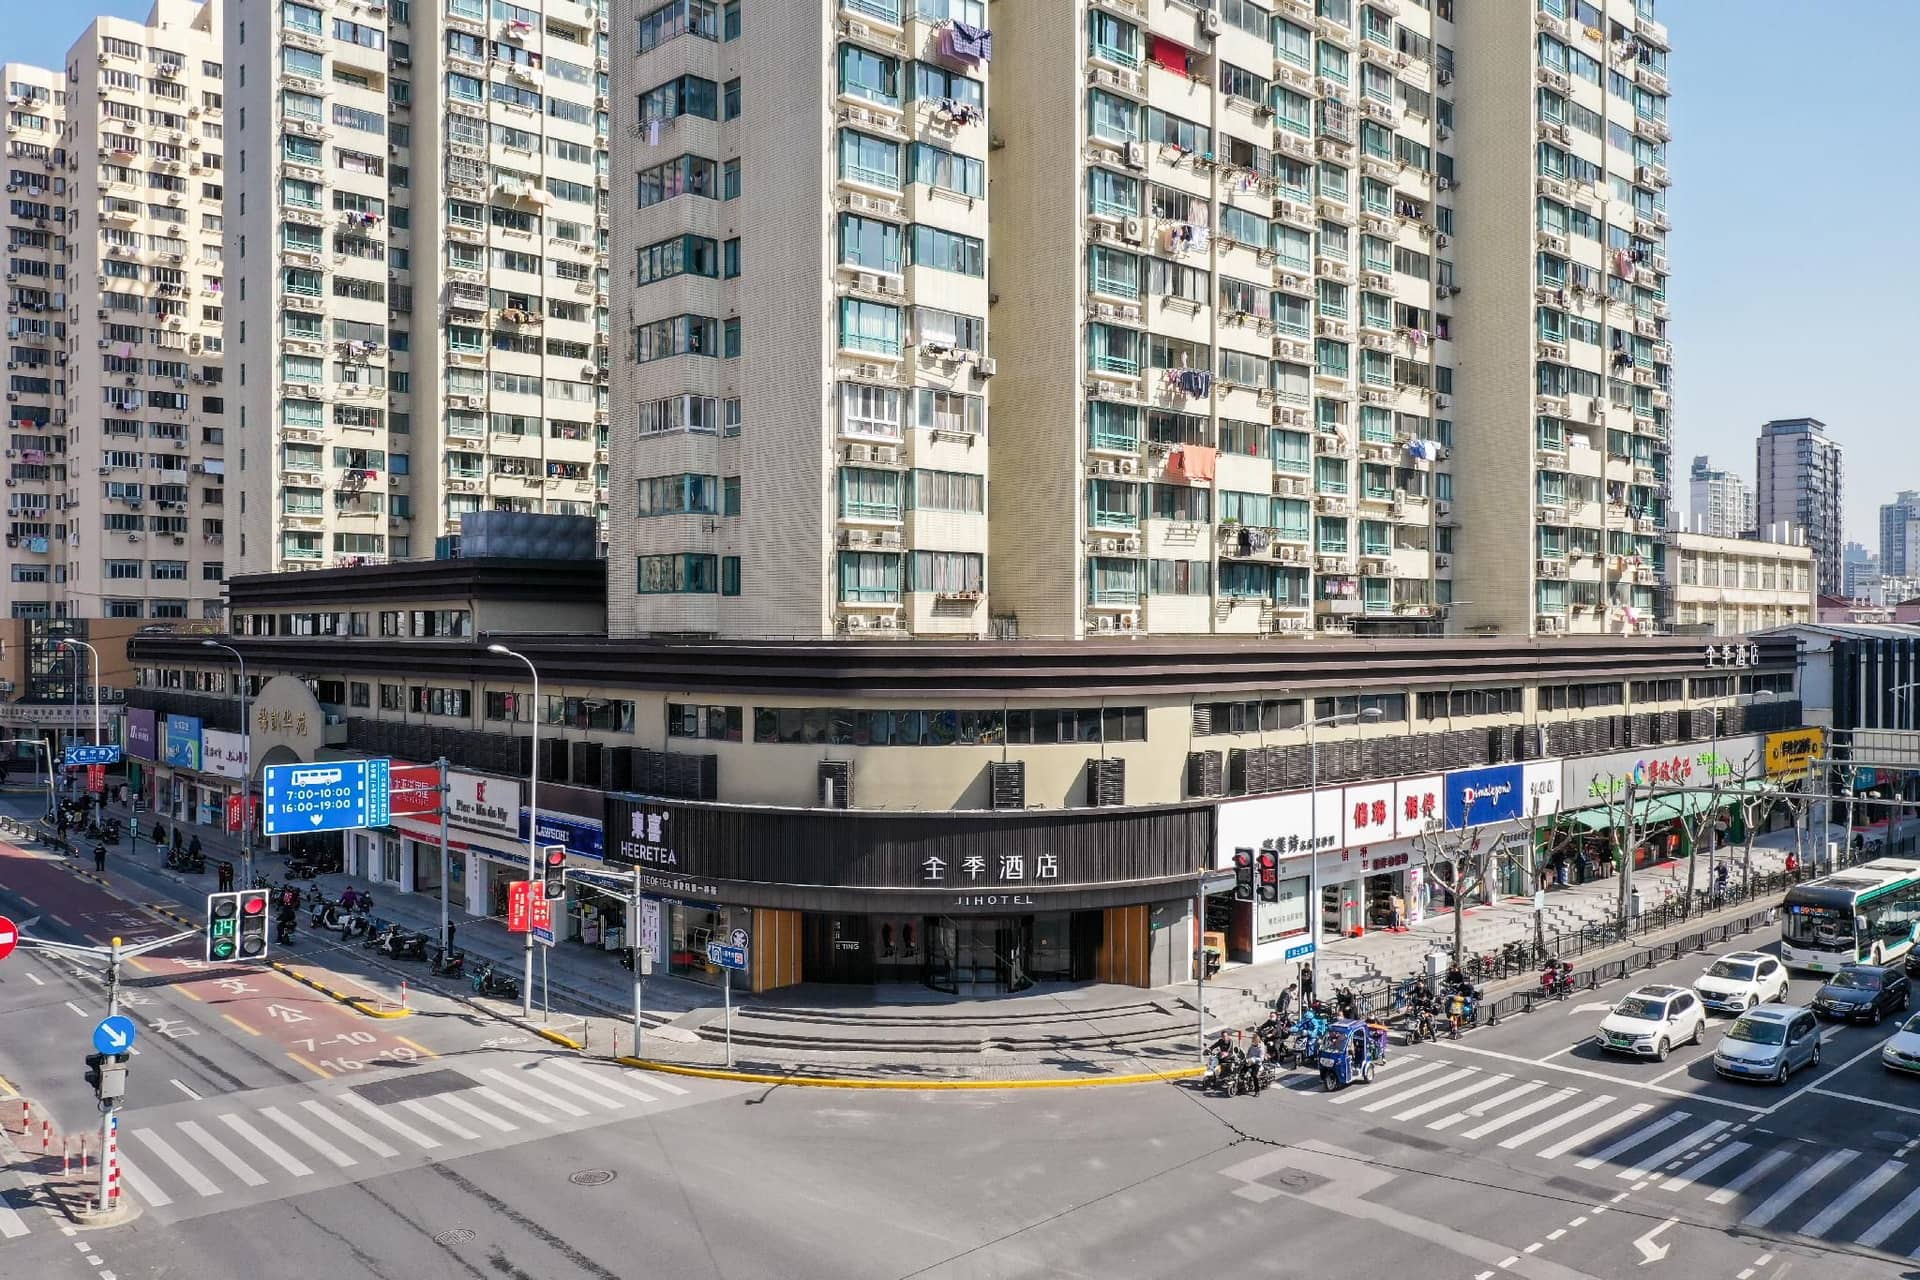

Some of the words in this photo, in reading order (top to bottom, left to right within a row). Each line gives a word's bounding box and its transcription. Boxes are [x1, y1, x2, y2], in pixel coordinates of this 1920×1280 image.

[1705, 643, 1760, 668] 全季酒店
[281, 799, 351, 814] 16:00-19:00
[286, 787, 351, 801] 7:00-10:00
[620, 840, 677, 865] HEERETEA
[922, 853, 1058, 880] 全季酒店
[292, 1031, 377, 1053] 7-10
[319, 1046, 418, 1073] 16-19
